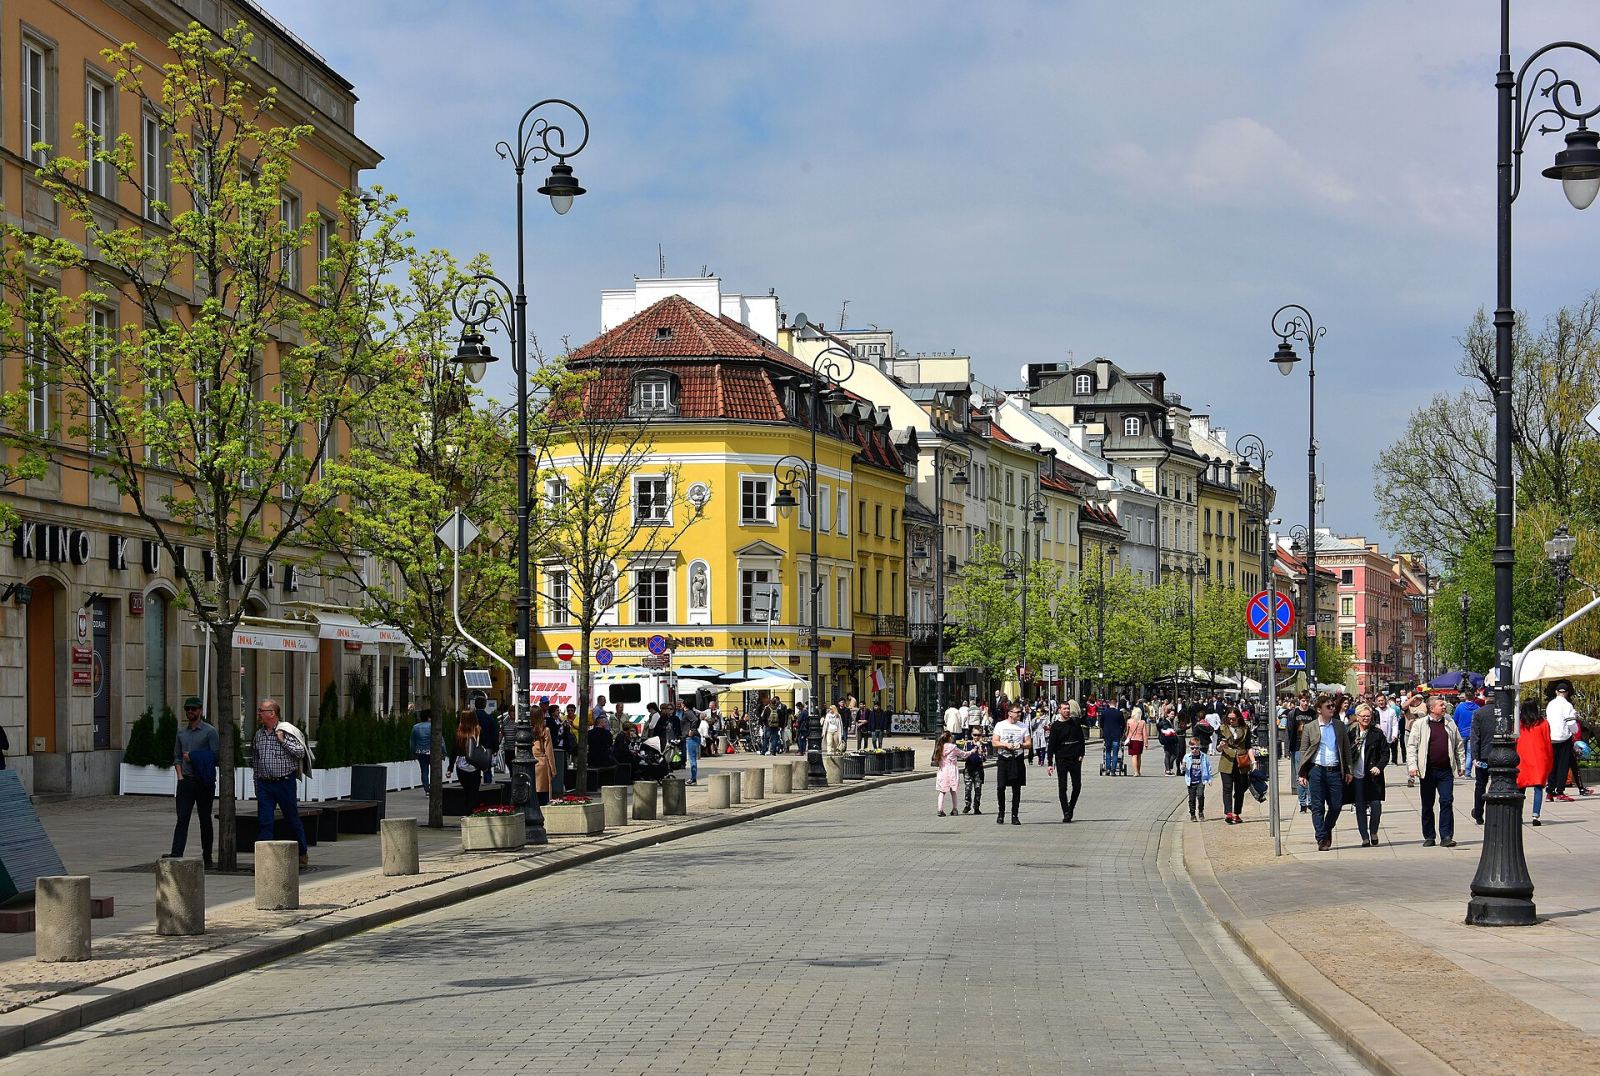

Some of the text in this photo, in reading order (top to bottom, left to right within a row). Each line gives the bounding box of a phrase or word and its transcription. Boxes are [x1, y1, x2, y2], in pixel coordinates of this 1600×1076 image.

[18, 521, 91, 565] KINO
[593, 637, 627, 649] green
[731, 637, 786, 646] TELIMENA
